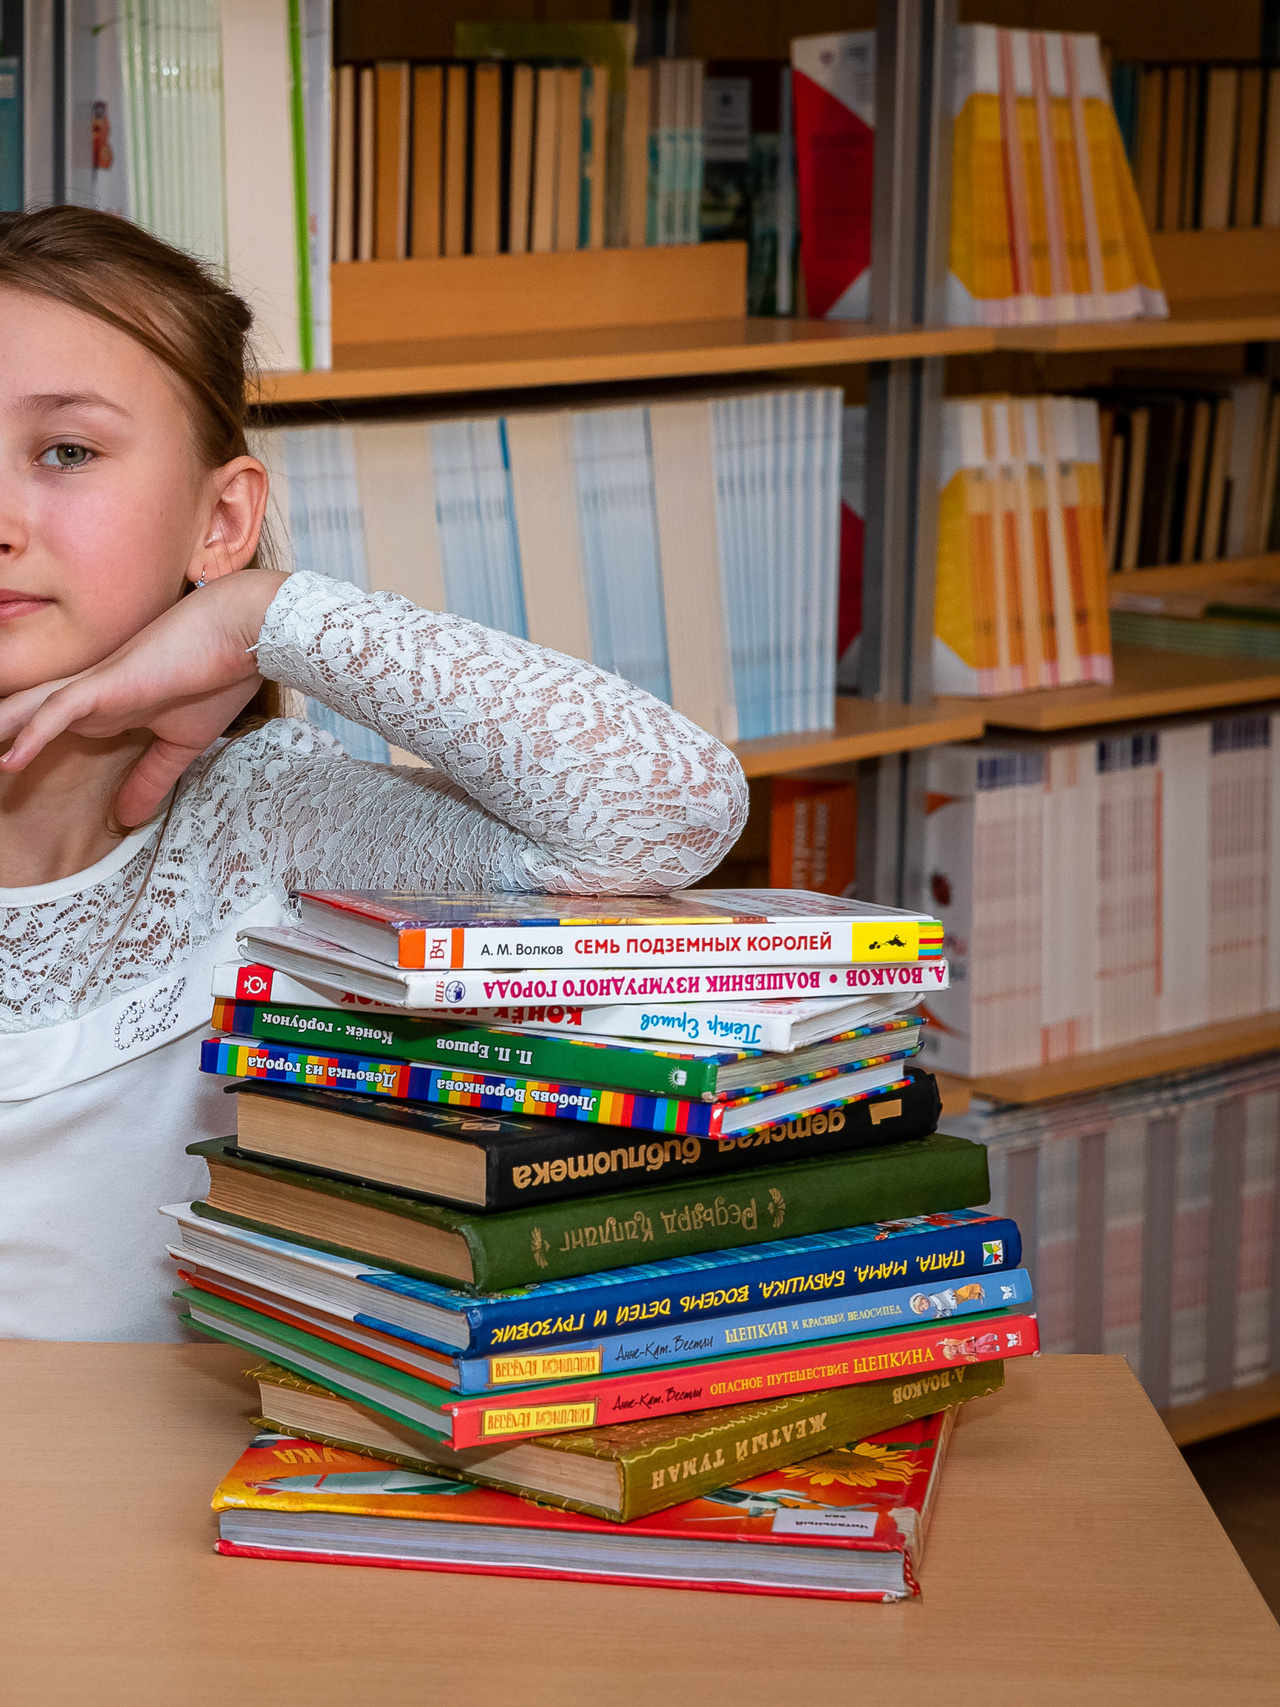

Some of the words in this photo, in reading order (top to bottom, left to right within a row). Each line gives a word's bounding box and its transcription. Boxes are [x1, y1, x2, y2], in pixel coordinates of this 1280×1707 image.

[430, 938, 446, 960] ВЧ
[480, 944, 494, 956] А.
[497, 944, 513, 956] М.
[515, 943, 564, 956] Волков
[574, 939, 620, 955] СЕМЬ
[625, 935, 741, 955] ПОДЗЕМНЫХ
[747, 931, 832, 952] КОРОЛЕЙ
[562, 974, 700, 998] ИЗУМРУДНОГО
[706, 971, 821, 993] ВОЛШЕБНИК
[846, 966, 924, 986] ВОЛКОВ
[928, 966, 946, 983] А.
[434, 980, 445, 1003] ШБ
[483, 978, 556, 997] ГОРОДА
[261, 1011, 334, 1036] горбунок
[345, 1025, 394, 1046] Конёк
[640, 1013, 700, 1039] Ершов
[707, 1013, 762, 1044] Пётр
[436, 1038, 490, 1059] Ершов
[494, 1046, 511, 1063] П.
[516, 1048, 533, 1065] П.
[247, 1055, 302, 1075] города
[305, 1064, 324, 1077] из
[327, 1065, 397, 1089] Девочка
[436, 1077, 526, 1103] Воронкова
[530, 1089, 597, 1112] Любовь
[869, 1099, 902, 1126] 1
[717, 1107, 847, 1153] детская
[511, 1136, 702, 1190] библиотека
[660, 1195, 758, 1234] Редьярд
[559, 1210, 655, 1252] Киплинг
[853, 1259, 907, 1284] МАМА,
[915, 1249, 966, 1273] ПАПА,
[758, 1269, 845, 1300] БАБУШКА,
[680, 1284, 750, 1314] ВОСЕМЬ
[593, 1308, 607, 1328] И
[614, 1298, 672, 1327] ДЕТЕЙ
[489, 1313, 586, 1346] ГРУЗОВИК
[615, 1340, 672, 1362] Анне-Кат.
[674, 1335, 714, 1352] Вестли
[725, 1320, 788, 1344] ЩЕПКИН
[791, 1319, 799, 1330] И
[802, 1312, 845, 1329] КРАСНЫЙ
[848, 1304, 903, 1322] ВЕЛОСИПЕД
[495, 1359, 538, 1378] ВЕСЁЛАЯ
[542, 1356, 596, 1375] КОМПАНИЯ
[612, 1390, 665, 1412] Анне-Кат.
[666, 1386, 703, 1404] Вестли
[709, 1376, 763, 1396] ОПАСНОЕ
[766, 1362, 850, 1387] ПУТЕШЕСТВИЕ
[853, 1348, 935, 1375] ЩЕПКИНА
[487, 1409, 532, 1431] ВЕСЁЛАЯ
[535, 1406, 592, 1427] КОМПАНИЯ
[735, 1412, 828, 1462] ЖЕЛТЫЙ
[651, 1456, 726, 1490] ТУМАН
[794, 1519, 869, 1531] Читальный
